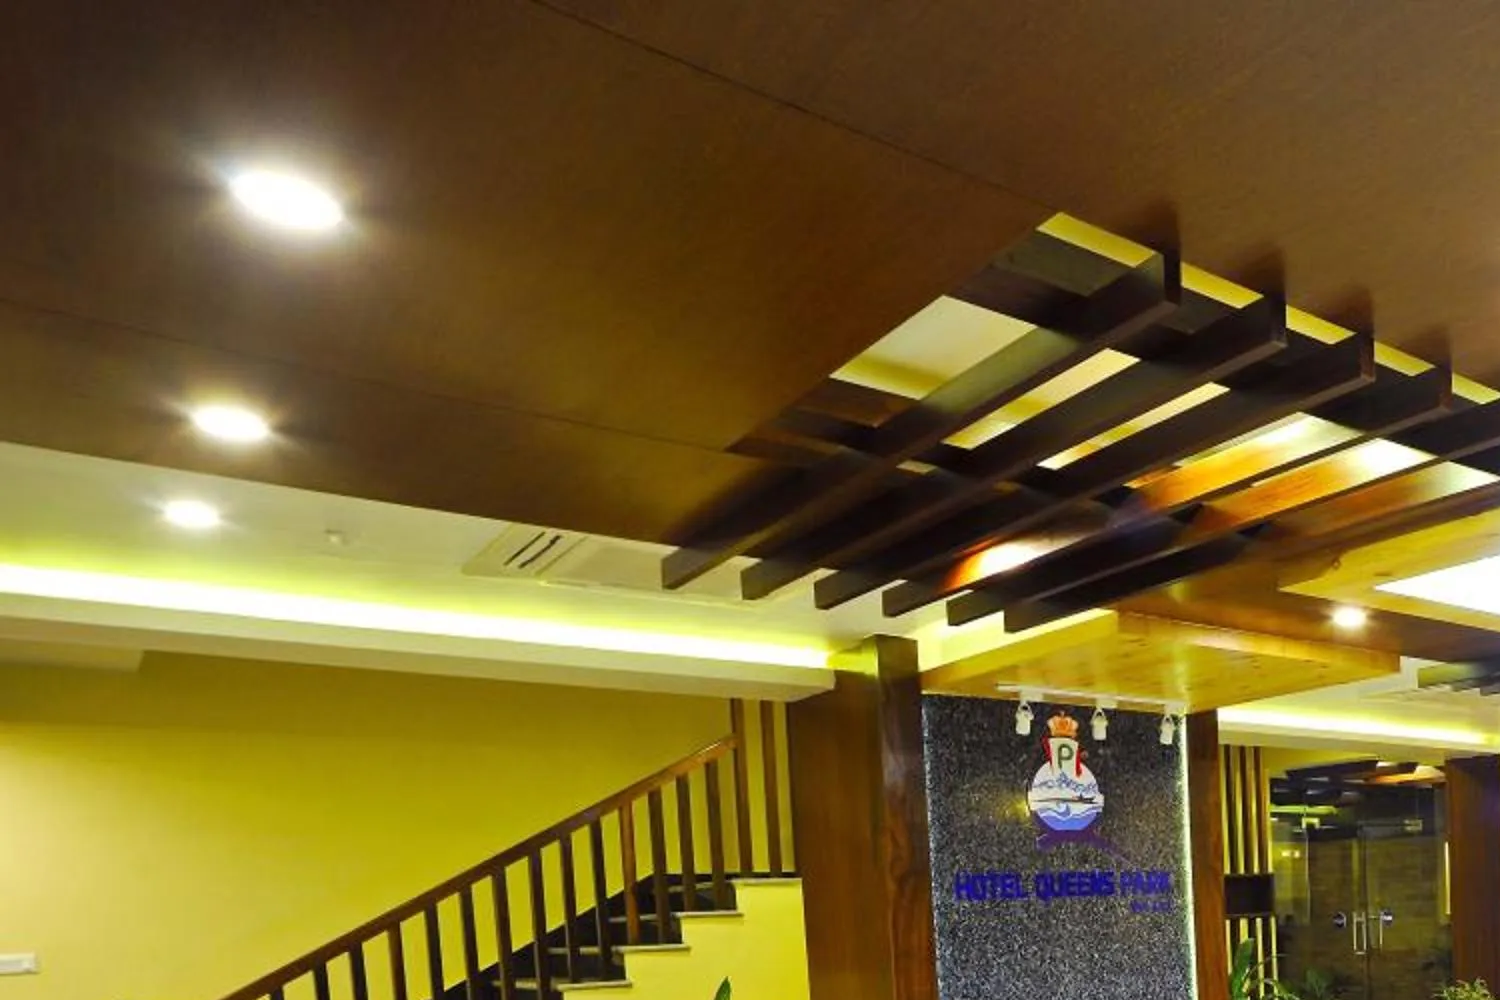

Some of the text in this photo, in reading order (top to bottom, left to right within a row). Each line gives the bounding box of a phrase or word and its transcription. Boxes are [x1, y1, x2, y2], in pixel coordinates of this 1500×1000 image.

[1058, 743, 1074, 768] P
[955, 870, 1172, 901] HOTEL QUEENS PARK
